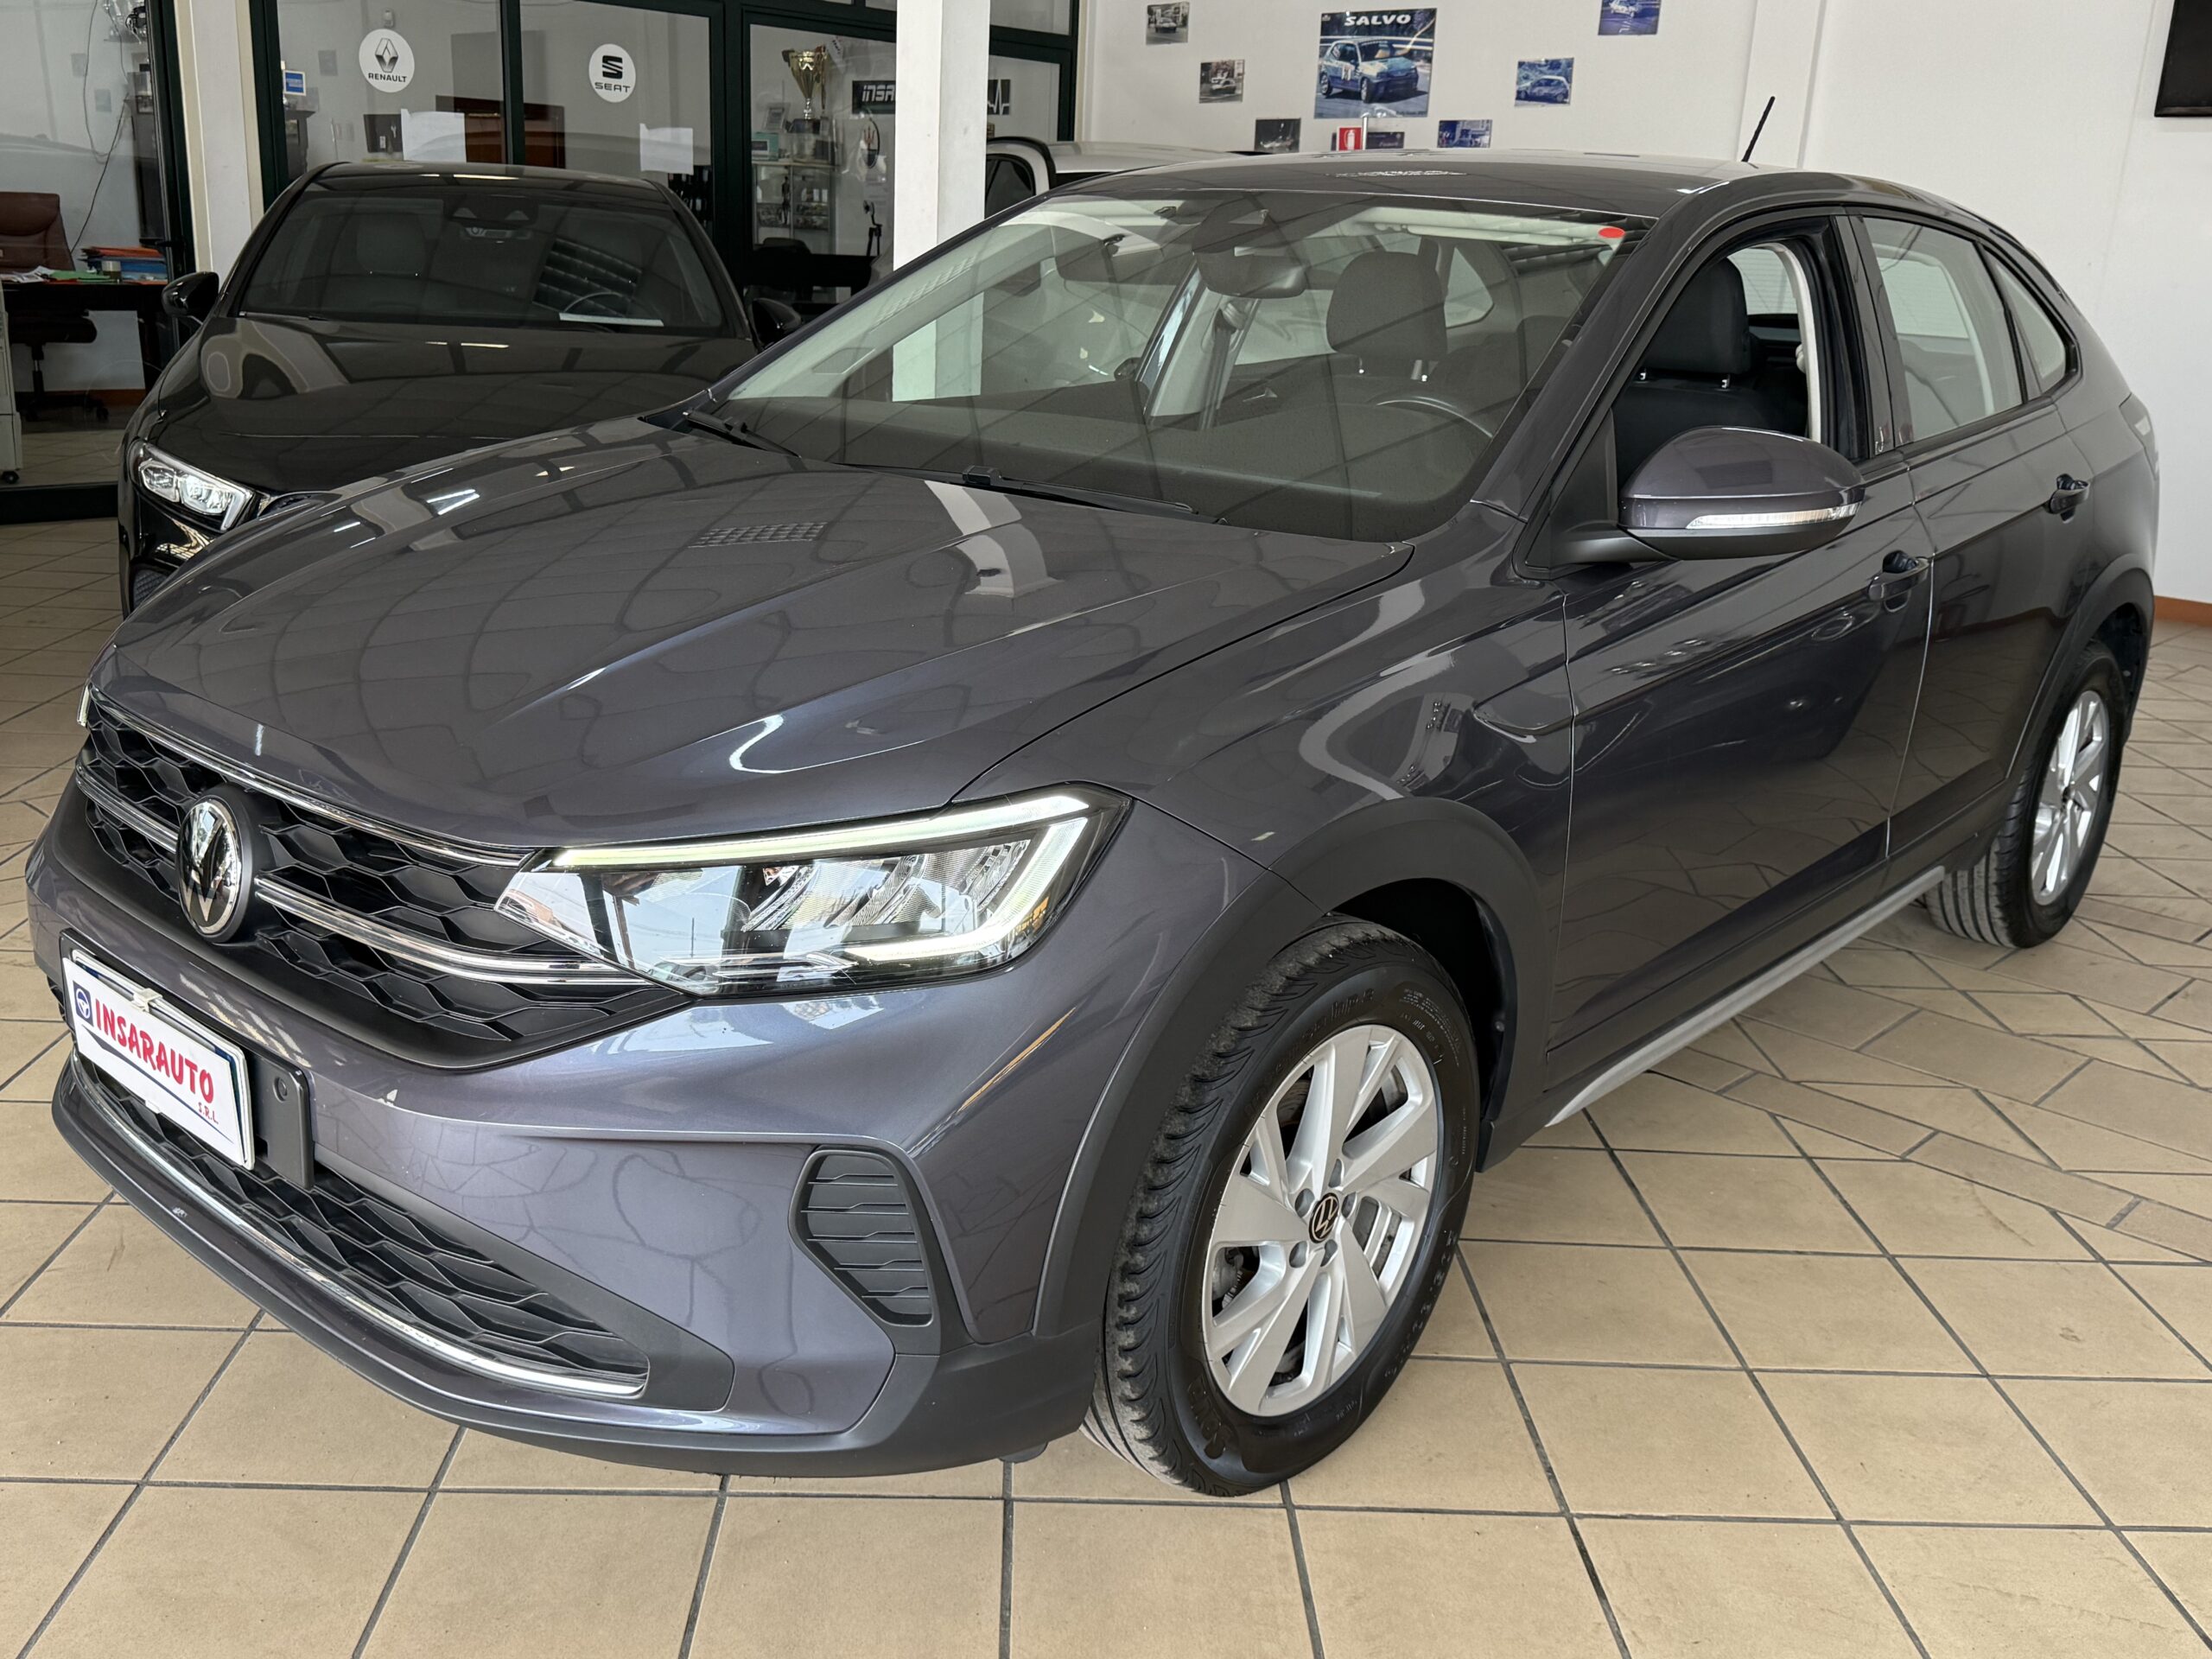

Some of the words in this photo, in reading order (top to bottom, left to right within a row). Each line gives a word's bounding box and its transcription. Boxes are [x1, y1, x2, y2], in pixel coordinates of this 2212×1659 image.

[1344, 14, 1411, 26] SALVO
[368, 73, 407, 82] RENAULT
[594, 82, 631, 92] SEAT
[95, 998, 214, 1104] INSARAUTO
